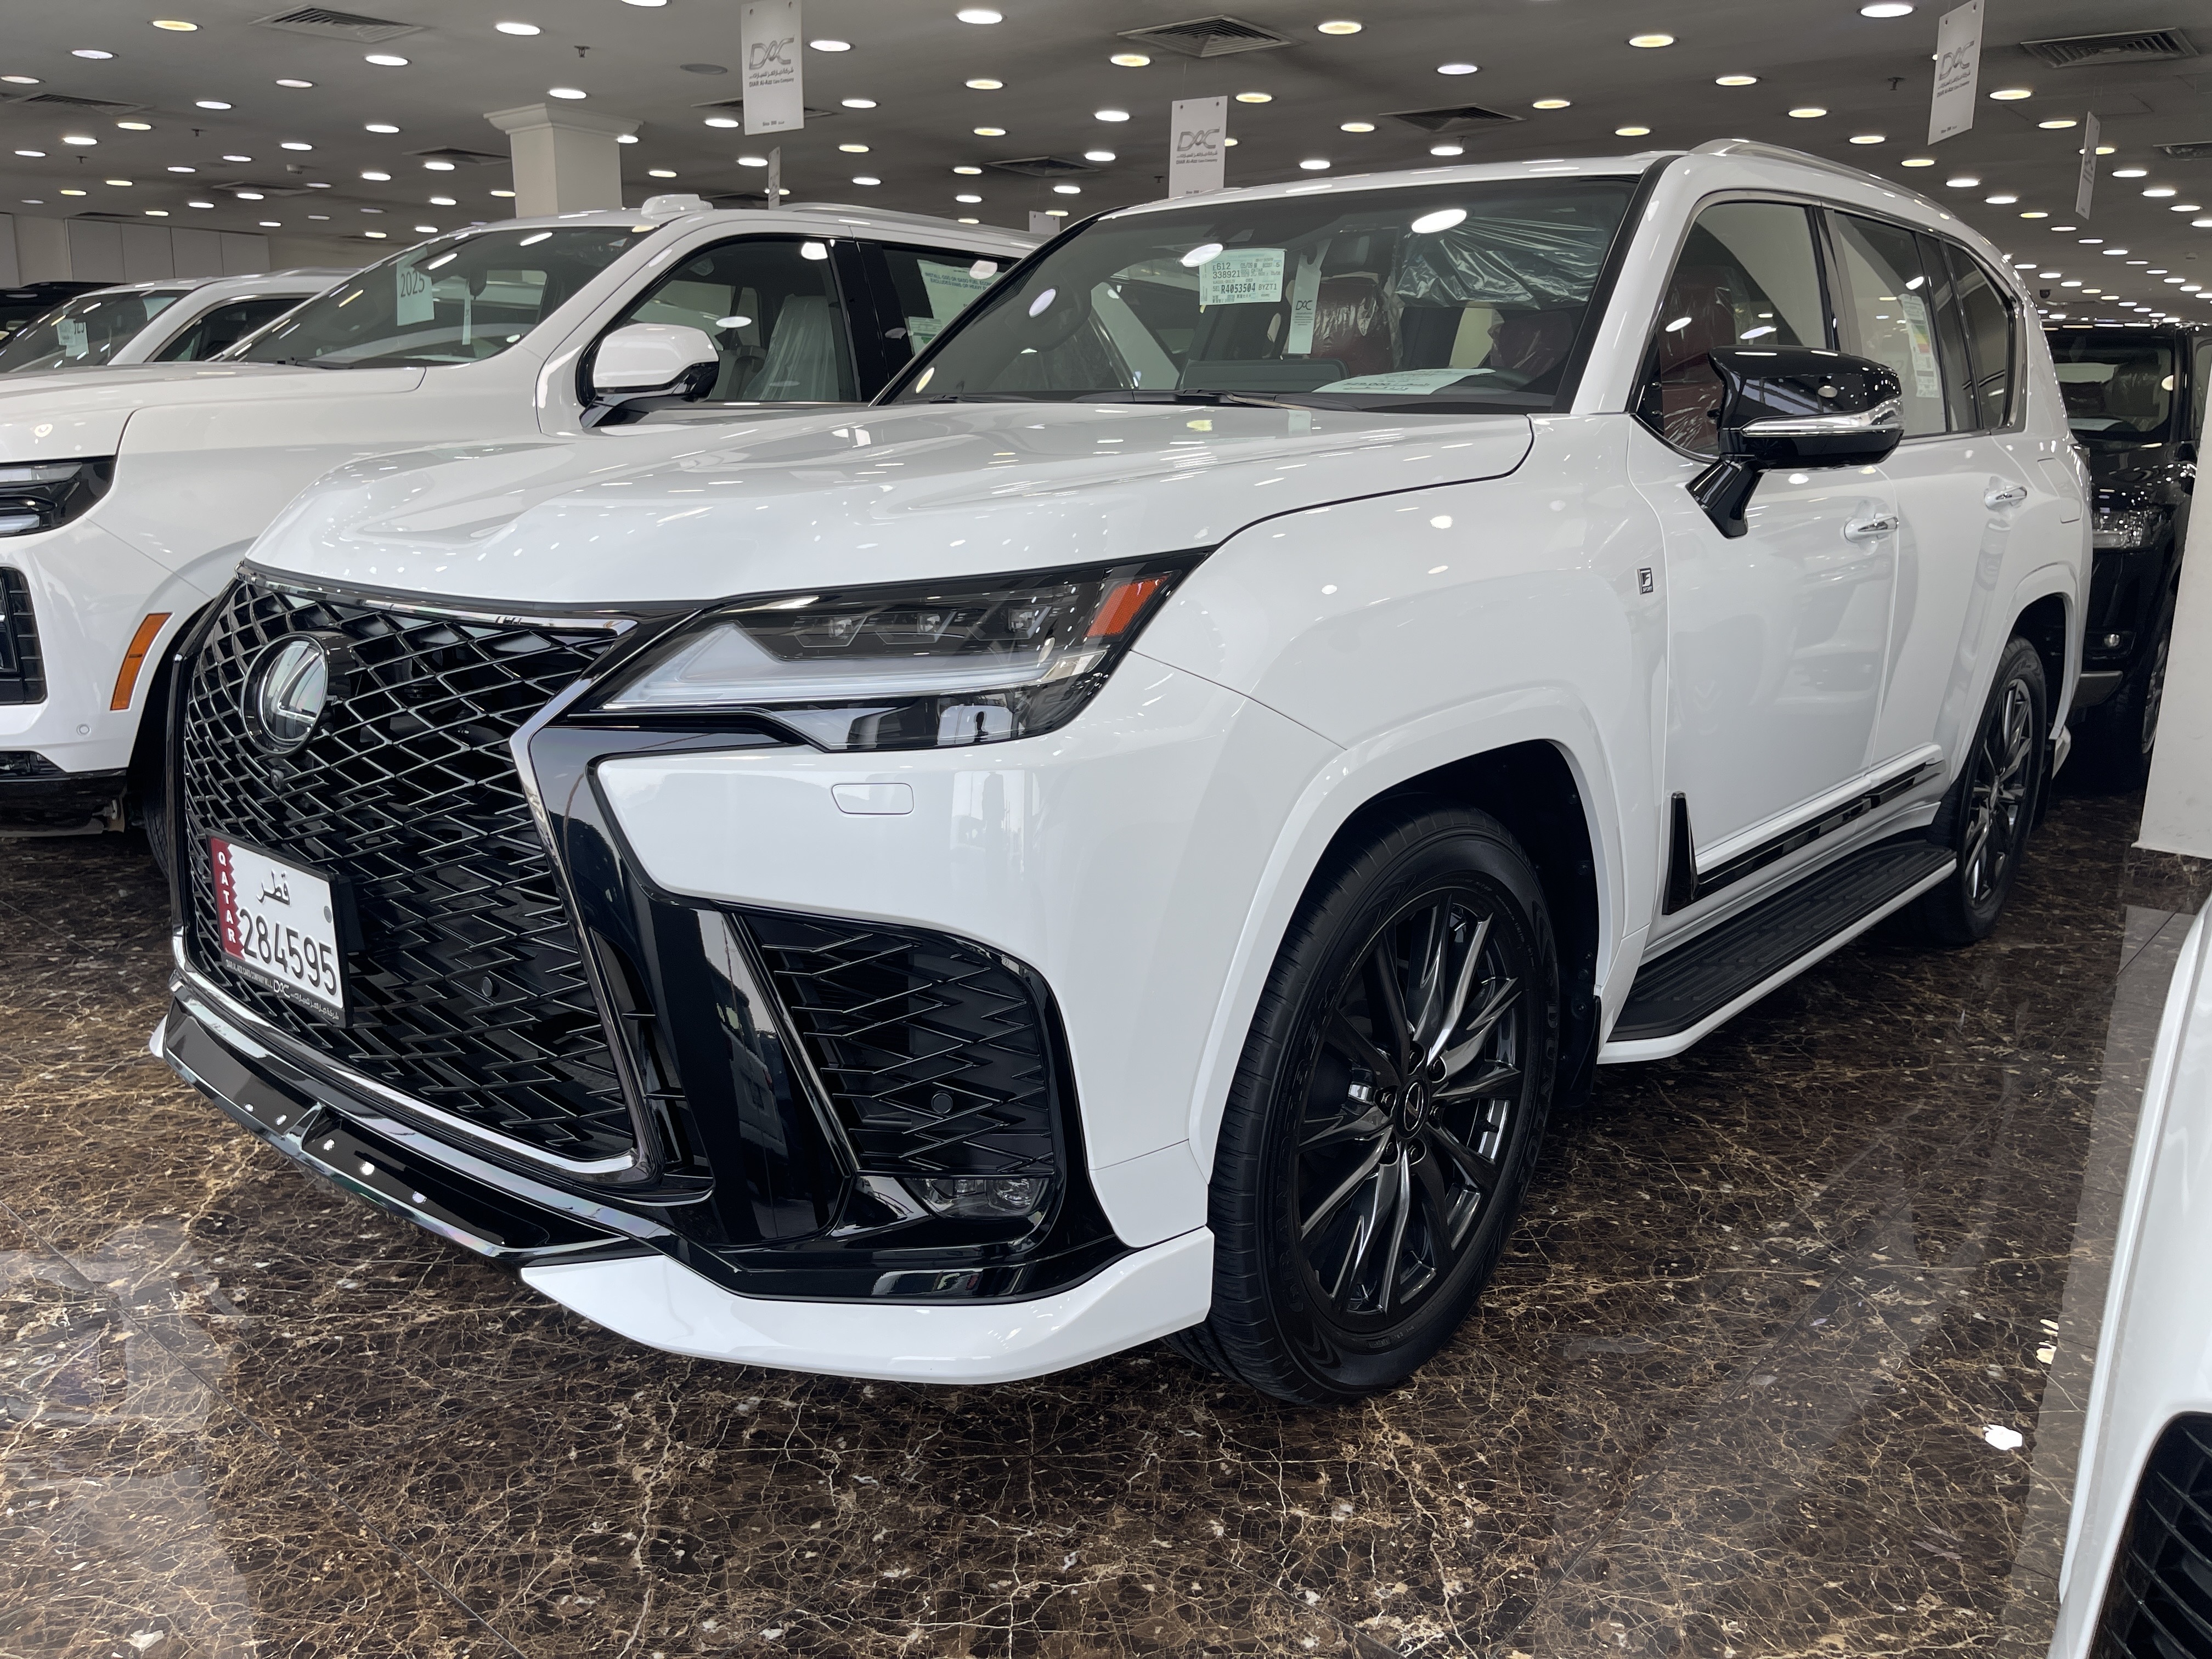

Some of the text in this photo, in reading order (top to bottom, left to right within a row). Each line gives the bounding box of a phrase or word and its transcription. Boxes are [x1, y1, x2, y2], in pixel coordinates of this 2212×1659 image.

[400, 270, 425, 298] 2025
[1212, 270, 1240, 279] 338921
[1221, 283, 1256, 294] R4053504
[218, 851, 236, 944] QATAR
[256, 868, 291, 905] قطر
[240, 907, 337, 996] 284595
